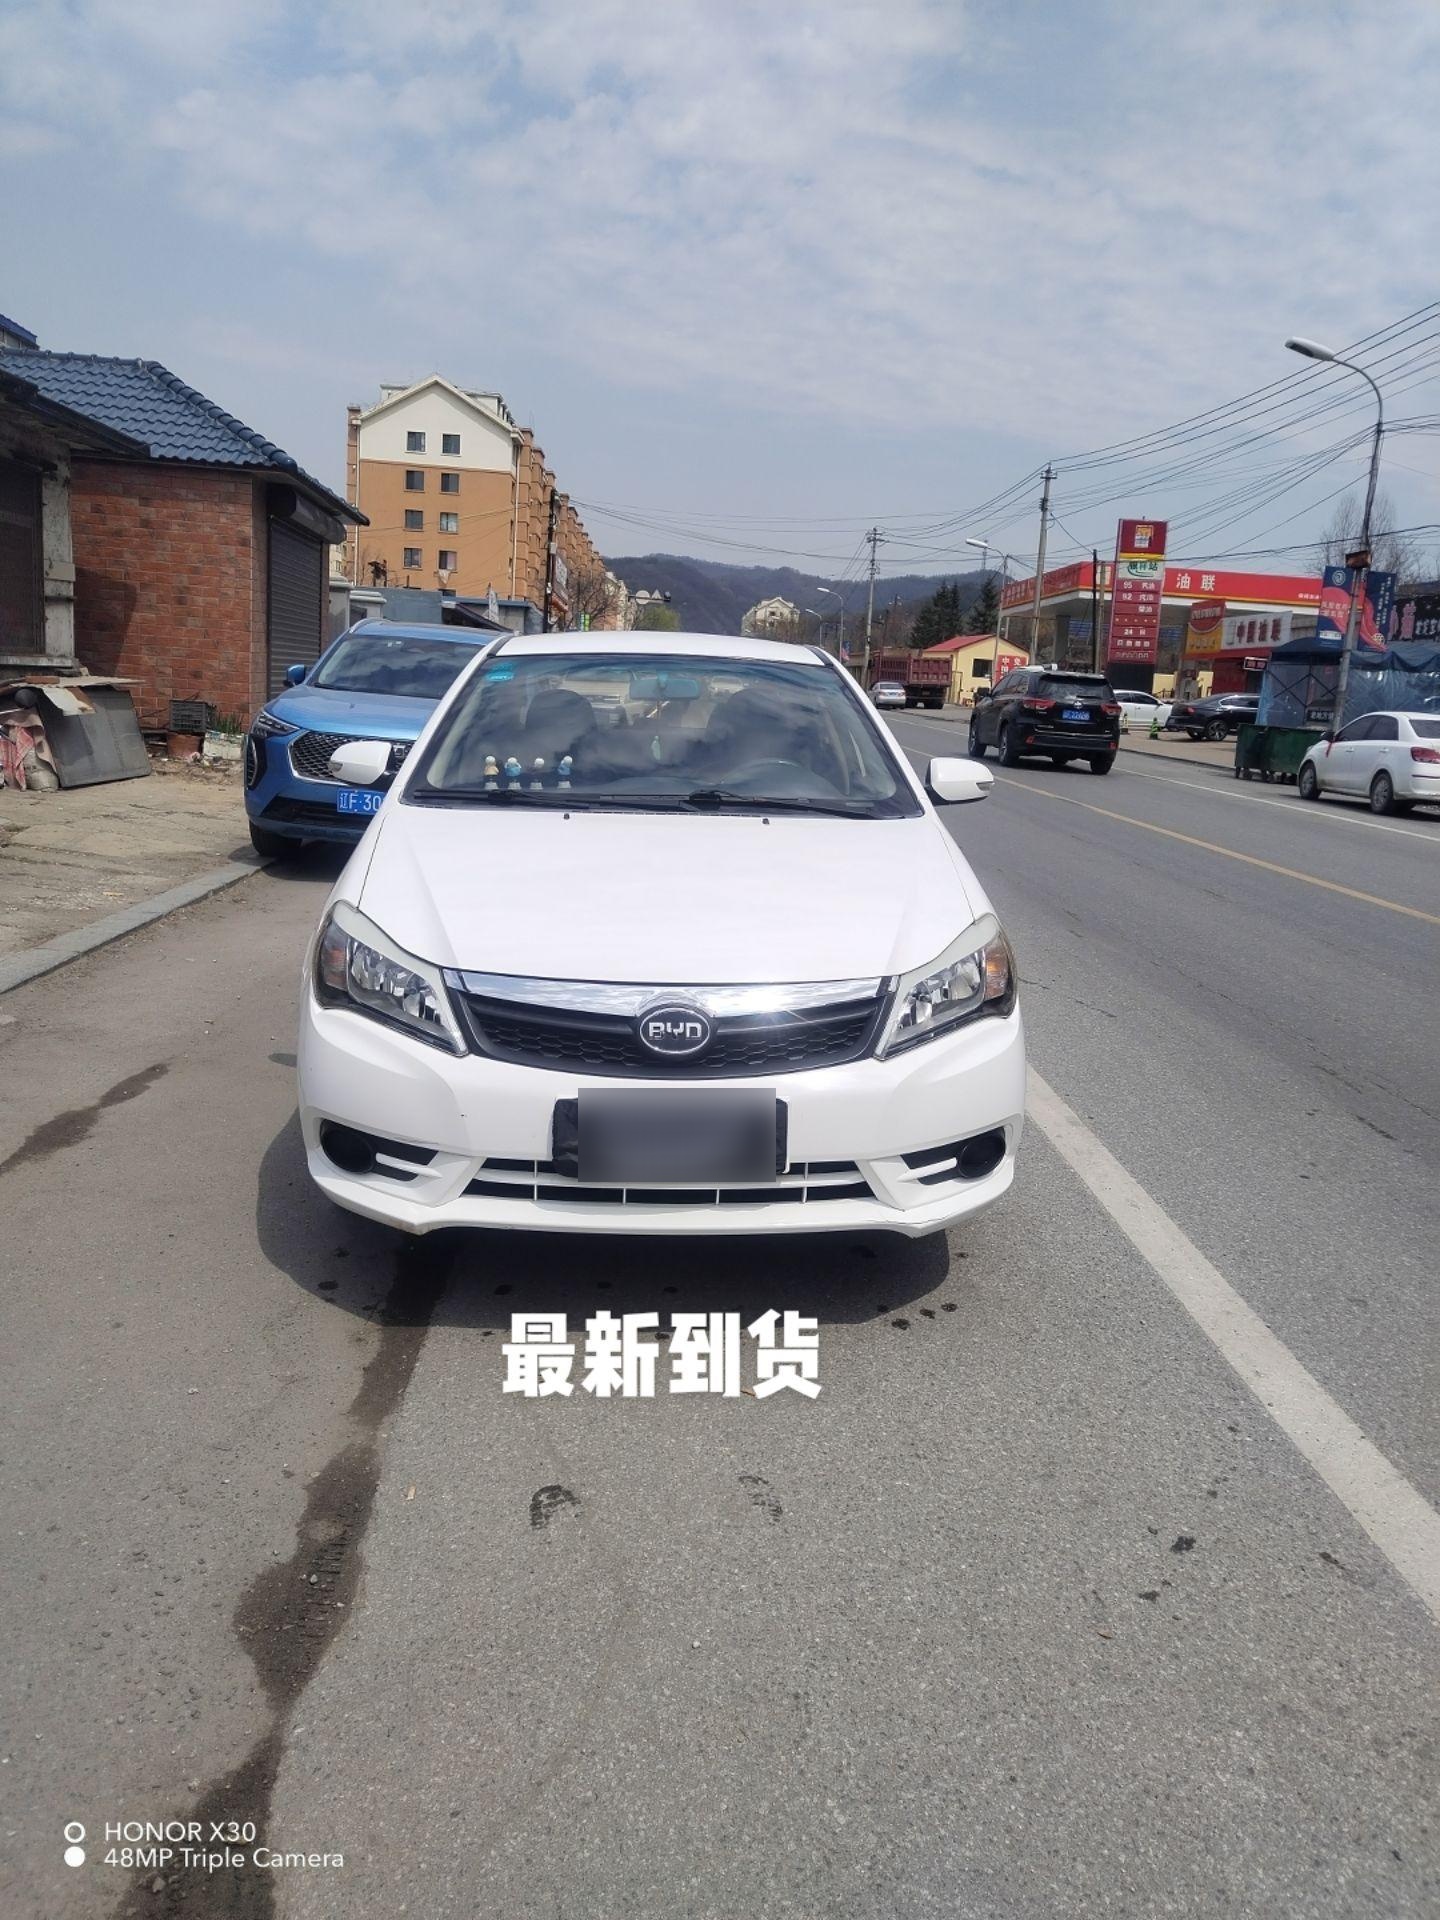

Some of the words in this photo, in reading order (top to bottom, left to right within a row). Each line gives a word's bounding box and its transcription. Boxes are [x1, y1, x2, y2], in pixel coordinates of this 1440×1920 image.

[1123, 581, 1133, 589] 95
[1176, 573, 1216, 592] 油联
[1122, 593, 1133, 601] 92
[648, 1022, 702, 1039] BYD
